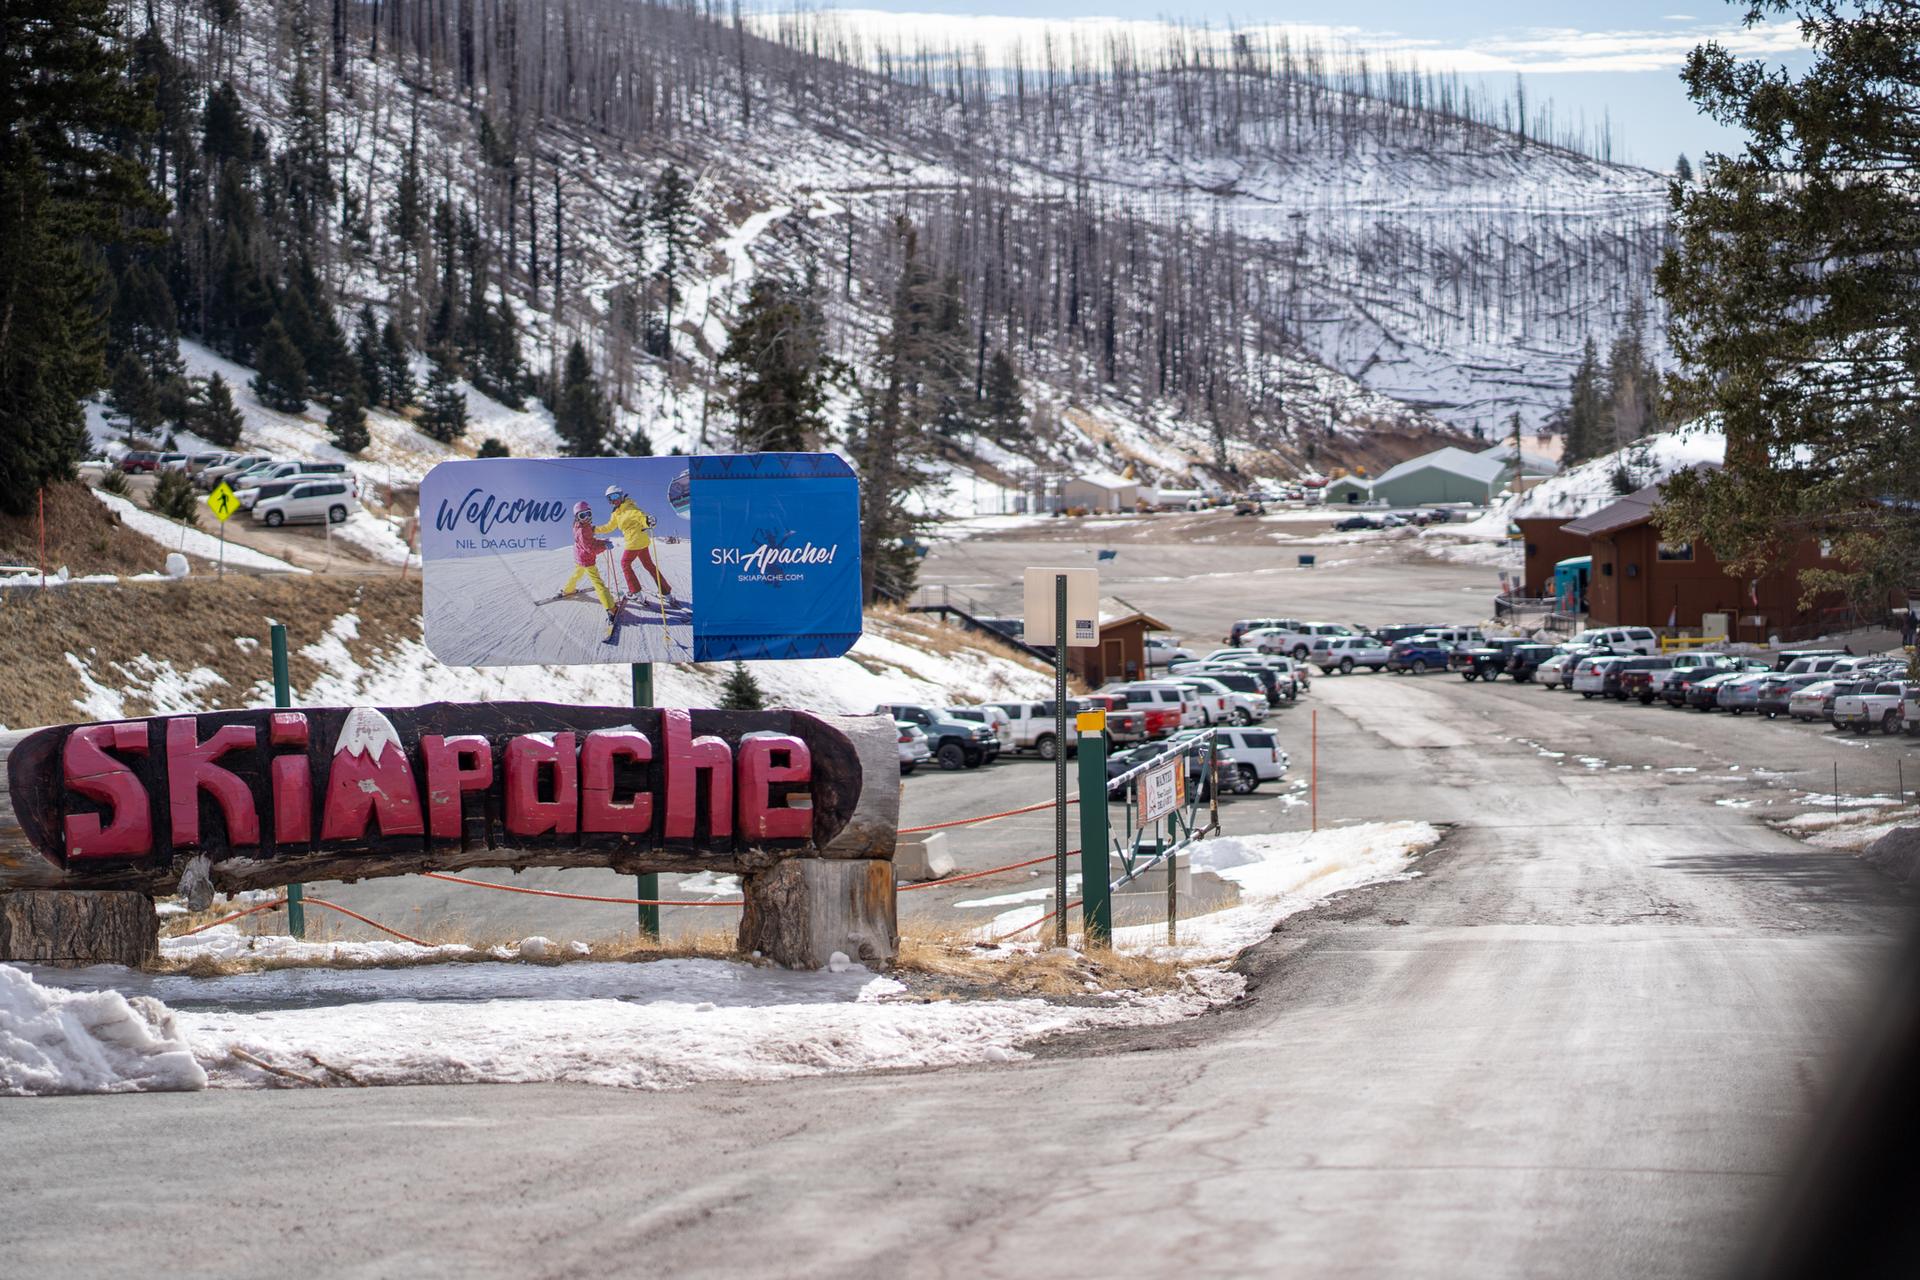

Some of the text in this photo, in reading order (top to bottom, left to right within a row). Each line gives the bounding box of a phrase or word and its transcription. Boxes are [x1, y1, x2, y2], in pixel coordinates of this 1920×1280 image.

[436, 488, 567, 535] Welcome
[711, 541, 838, 575] SKI Apache!
[738, 574, 804, 582] SKIAPACHE.COM
